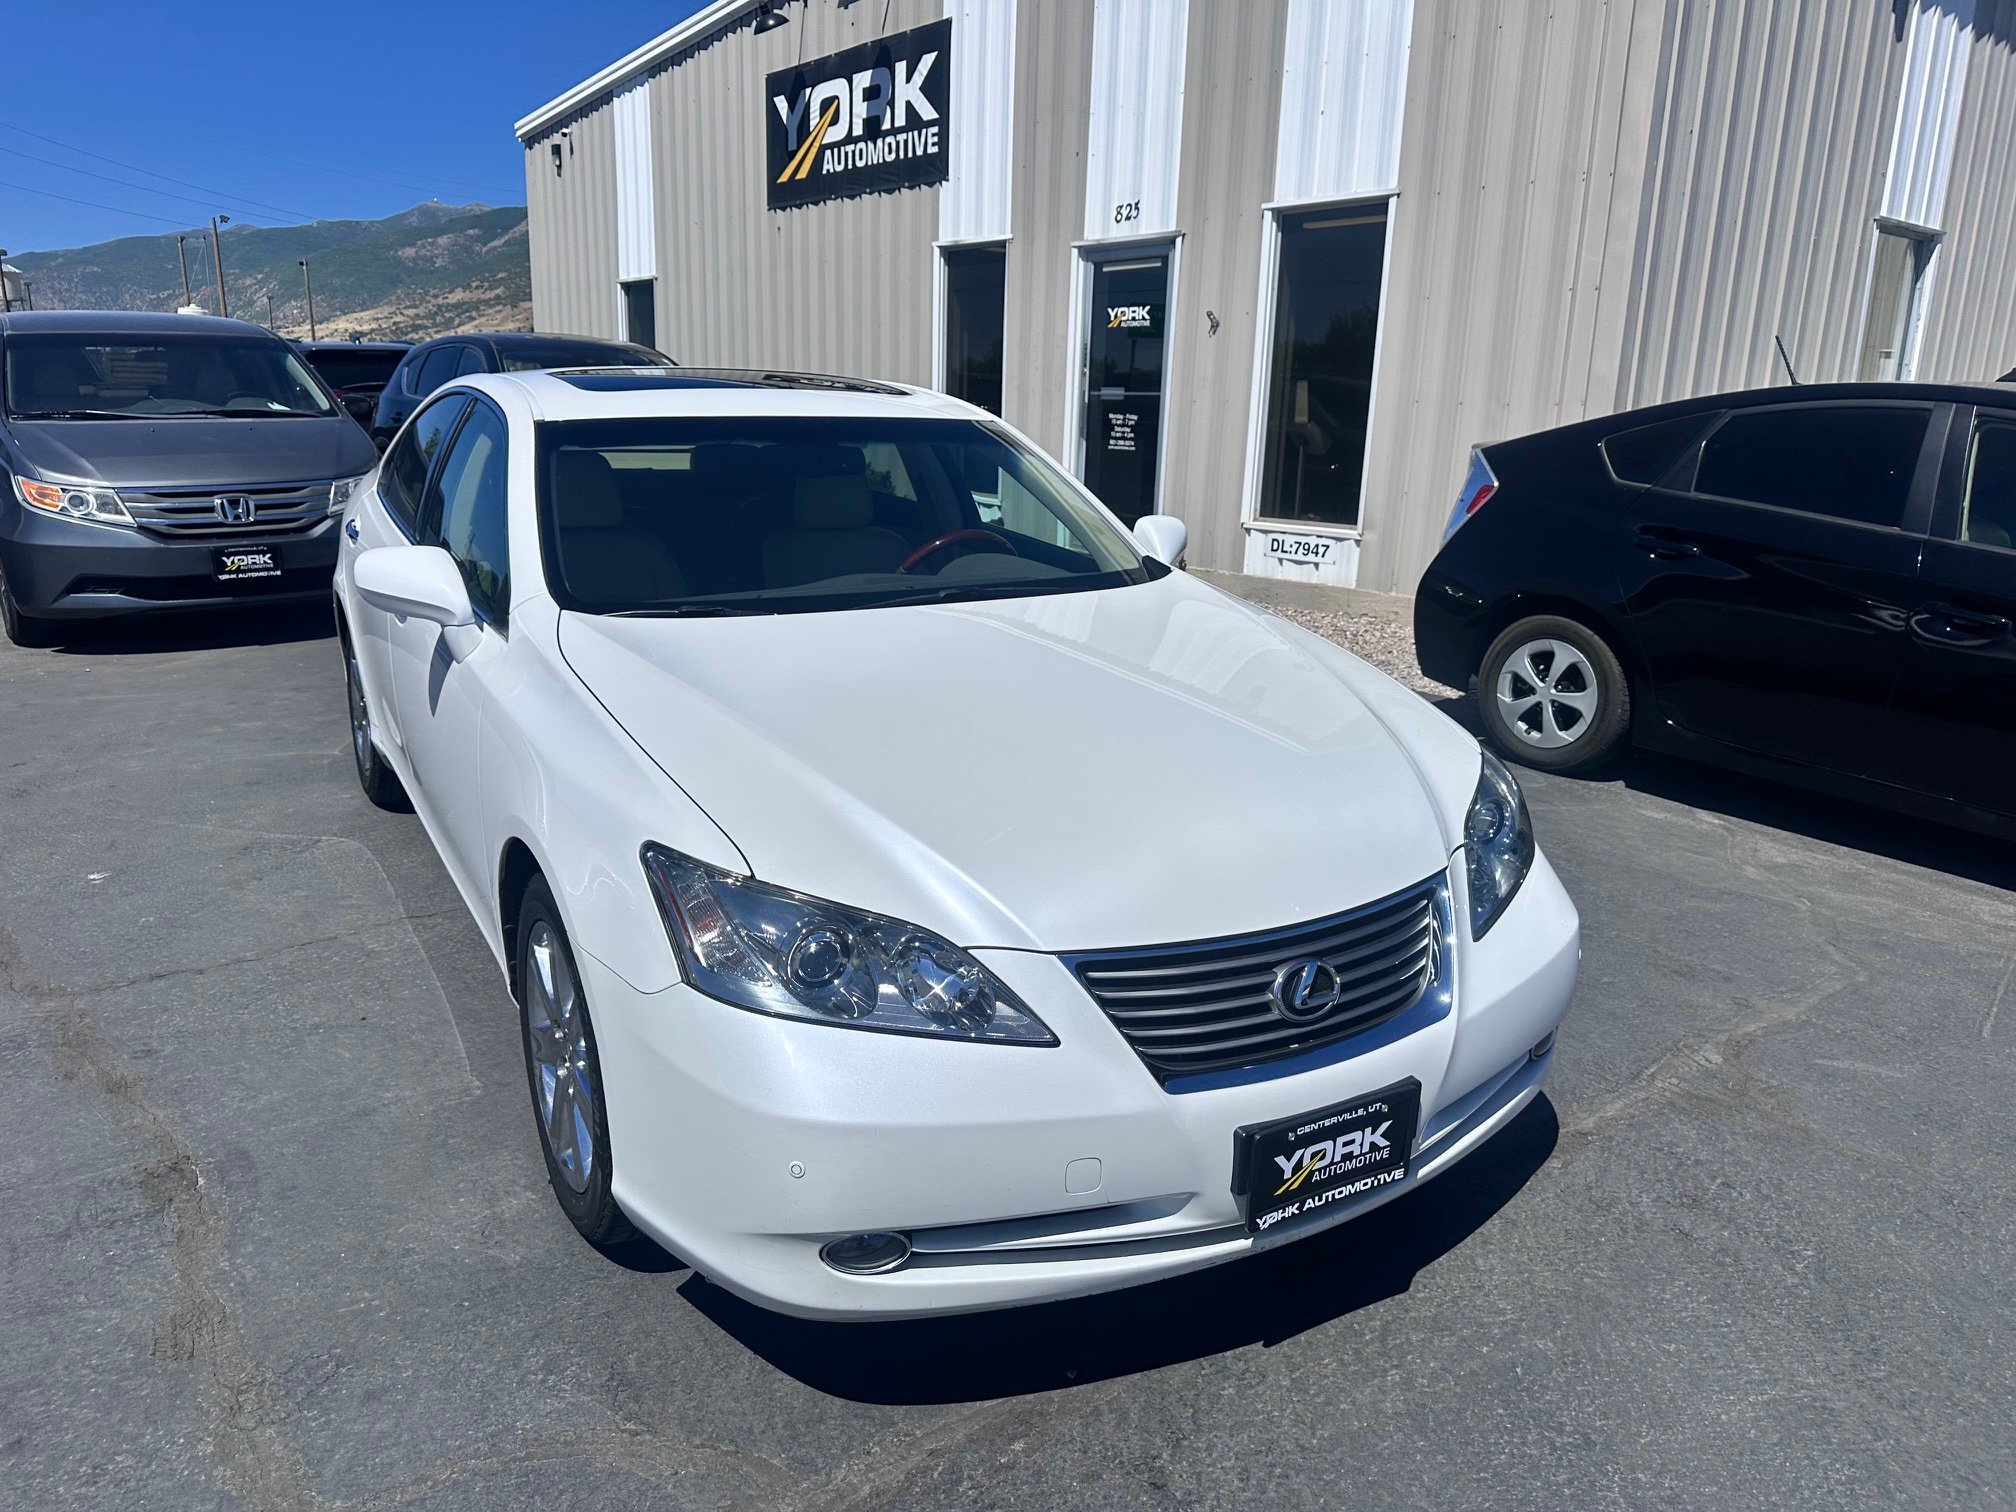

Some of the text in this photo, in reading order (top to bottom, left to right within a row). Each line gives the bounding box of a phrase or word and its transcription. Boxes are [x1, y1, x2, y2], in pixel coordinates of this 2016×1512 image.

[773, 51, 940, 151] YORK
[822, 126, 939, 174] AUTOMOTIVE
[1114, 200, 1140, 224] 825
[1107, 305, 1151, 321] YORK
[222, 554, 272, 566] YORK
[1270, 538, 1330, 558] DL:7947
[1296, 1102, 1382, 1135] CENTERVILLE, UT
[1274, 1120, 1393, 1180] YORK
[1311, 1147, 1391, 1183] AUTOMOTIVE
